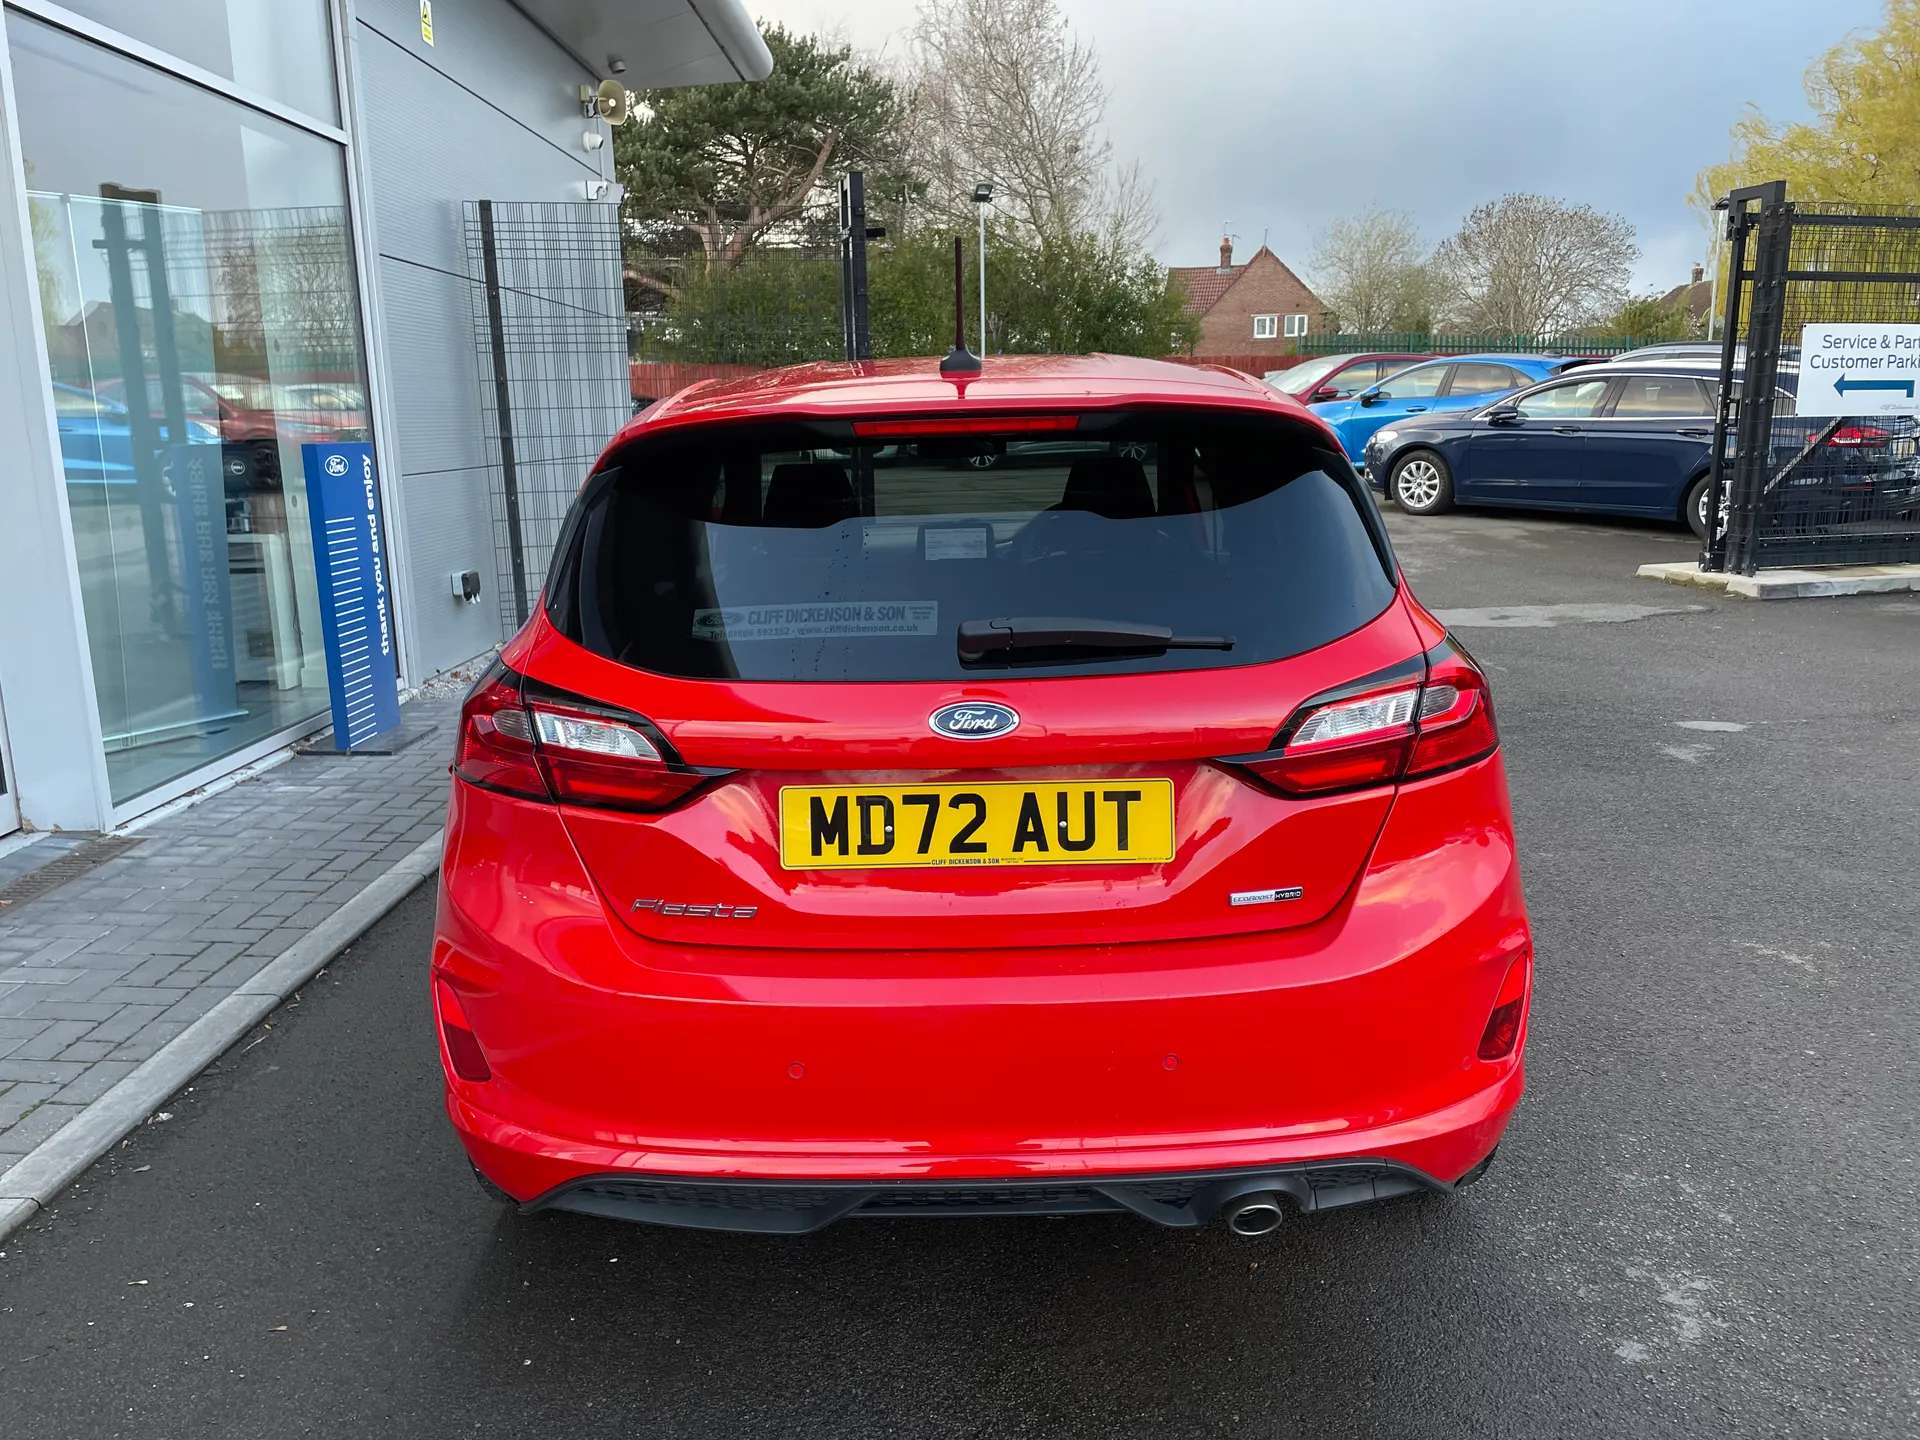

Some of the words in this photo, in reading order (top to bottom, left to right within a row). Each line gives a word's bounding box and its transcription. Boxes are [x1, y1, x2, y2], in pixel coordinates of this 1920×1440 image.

[1822, 334, 1877, 349] Service
[1880, 334, 1891, 349] &
[1810, 354, 1884, 369] Customer
[362, 453, 375, 510] enjoy
[367, 514, 379, 554] and
[373, 557, 385, 593] you
[376, 596, 390, 656] thank
[747, 609, 783, 625] CLIFF
[785, 606, 861, 623] DICKENSON
[863, 606, 874, 621] &
[876, 605, 906, 621] SON
[949, 709, 998, 730] Ford
[809, 793, 988, 856] MD72
[1012, 790, 1142, 853] AUT
[631, 898, 758, 918] Fiesta
